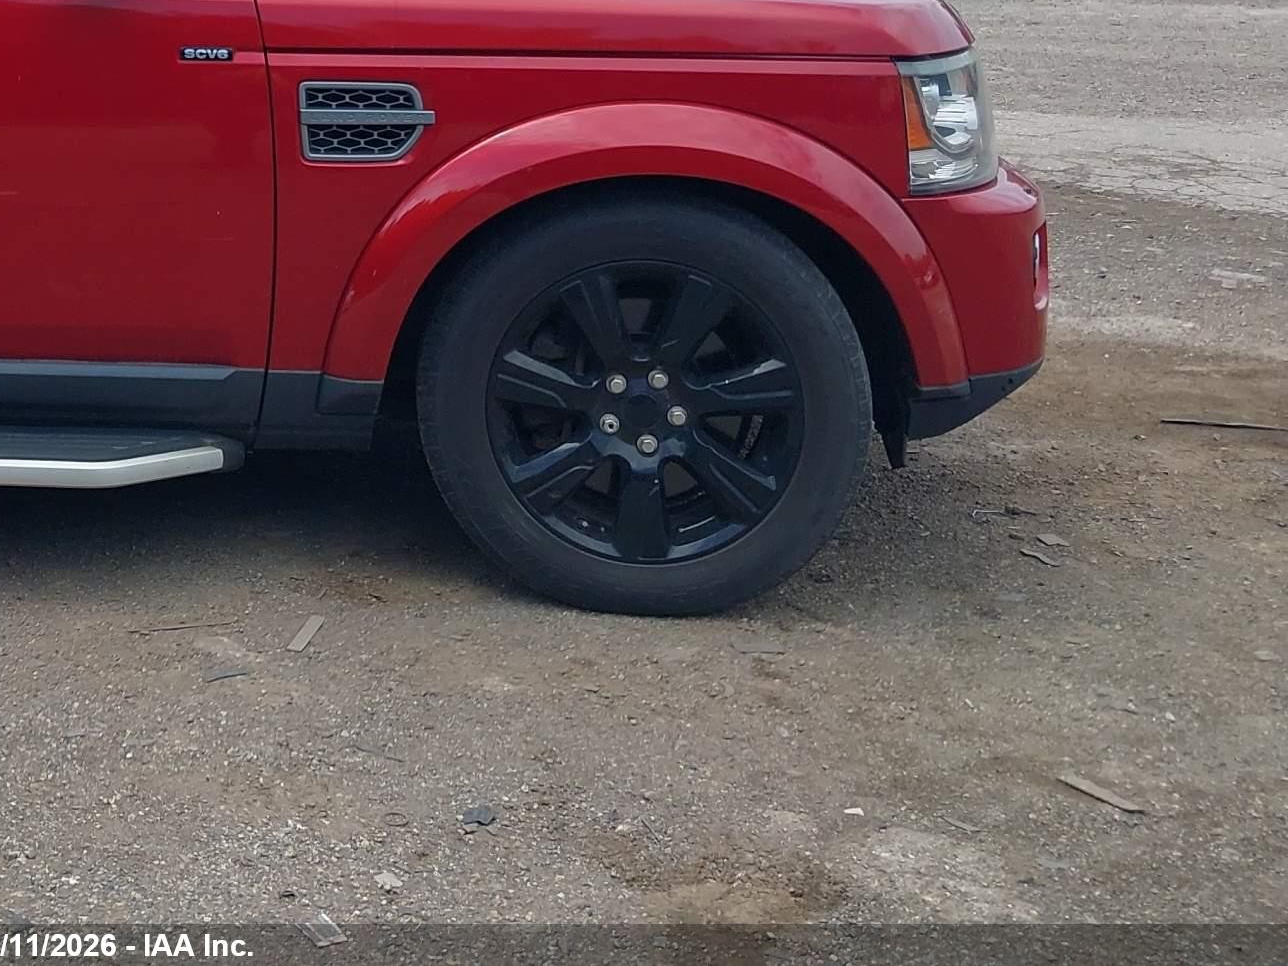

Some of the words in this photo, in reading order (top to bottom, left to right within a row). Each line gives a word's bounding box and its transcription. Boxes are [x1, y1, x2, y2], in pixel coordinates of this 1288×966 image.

[183, 48, 229, 59] SCV6
[310, 113, 356, 123] LAND
[365, 114, 425, 124] ROVER
